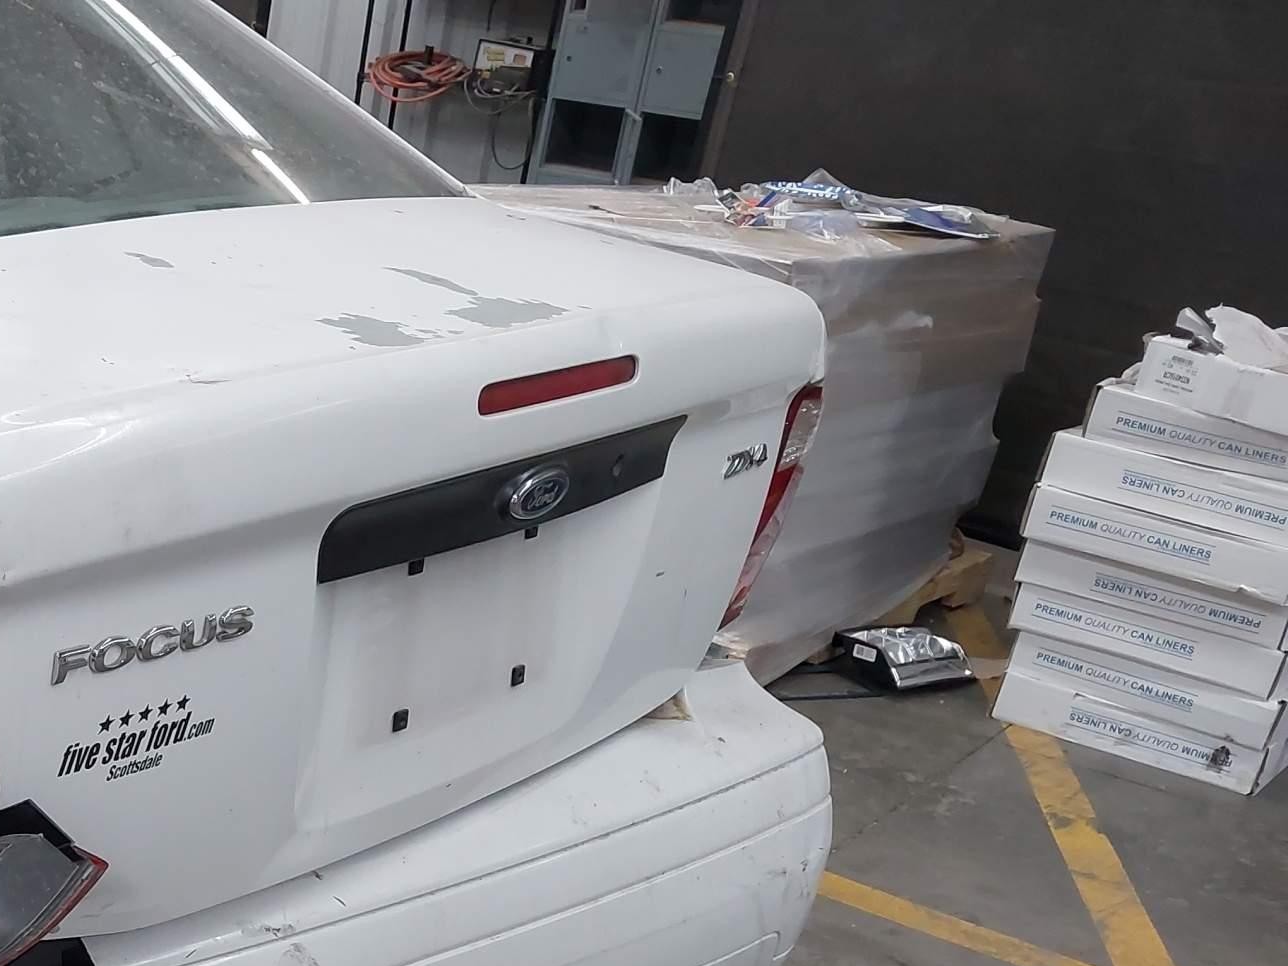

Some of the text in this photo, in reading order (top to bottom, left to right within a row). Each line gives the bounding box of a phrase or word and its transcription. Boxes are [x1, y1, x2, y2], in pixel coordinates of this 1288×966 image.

[1115, 416, 1287, 464] PREMIUM QUALITY CAN LINERS
[1121, 475, 1287, 525] PREMIUM QUALITY CAN LINERS
[1049, 510, 1212, 559] PREMIUM QUALITY CAN LINERS
[1094, 578, 1261, 628] PREMIUM QUALITY CAN LINERS
[51, 605, 255, 686] FOCUS
[1035, 603, 1195, 655] PREMIUM QUALITY CAN LINERS
[1036, 652, 1194, 707] PREMIUM QUALITY CAN LINERS
[57, 711, 215, 778] five star ford.com
[1069, 712, 1107, 731] LINERS
[1109, 723, 1132, 737] CAN
[1133, 733, 1179, 751] QUALITY
[106, 752, 163, 781] Scottsdale
